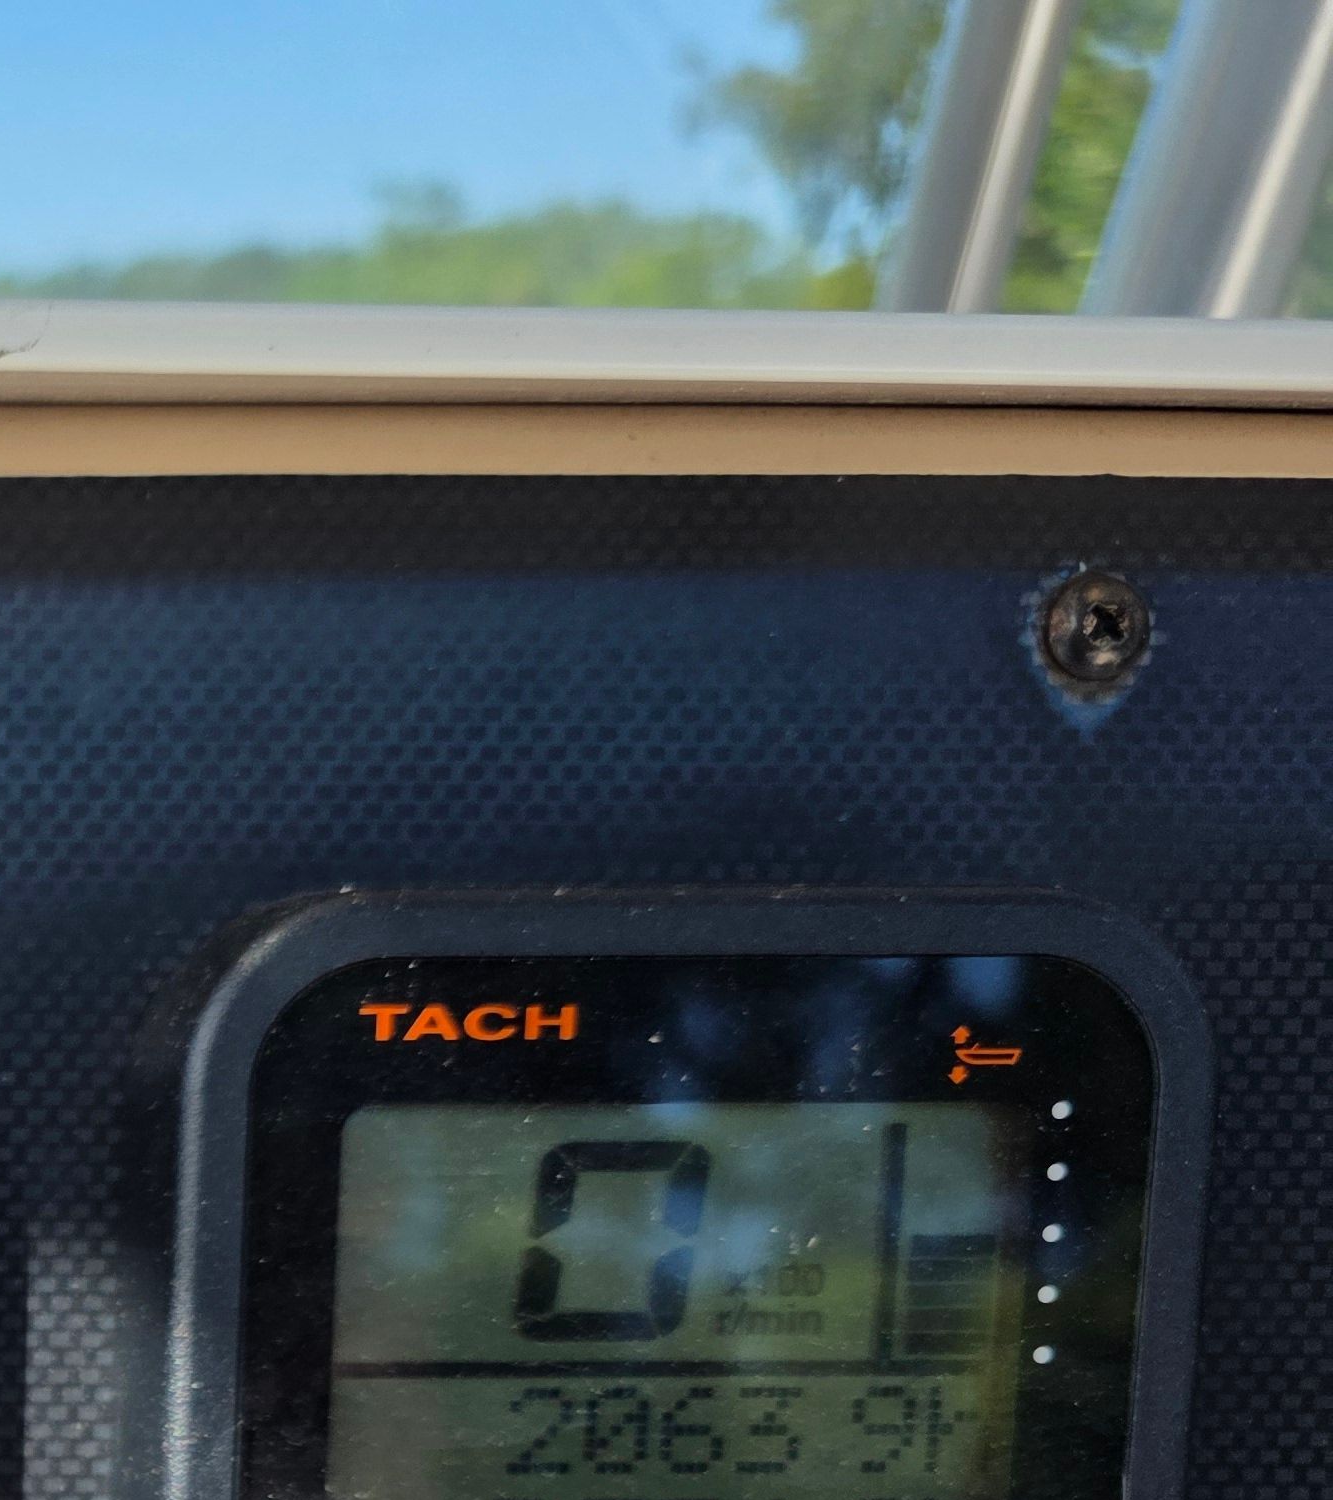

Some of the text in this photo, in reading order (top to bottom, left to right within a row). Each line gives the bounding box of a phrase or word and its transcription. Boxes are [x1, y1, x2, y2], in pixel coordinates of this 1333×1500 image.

[357, 1002, 580, 1042] TACH
[513, 1139, 712, 1342] 0
[505, 1386, 803, 1475] 2063
